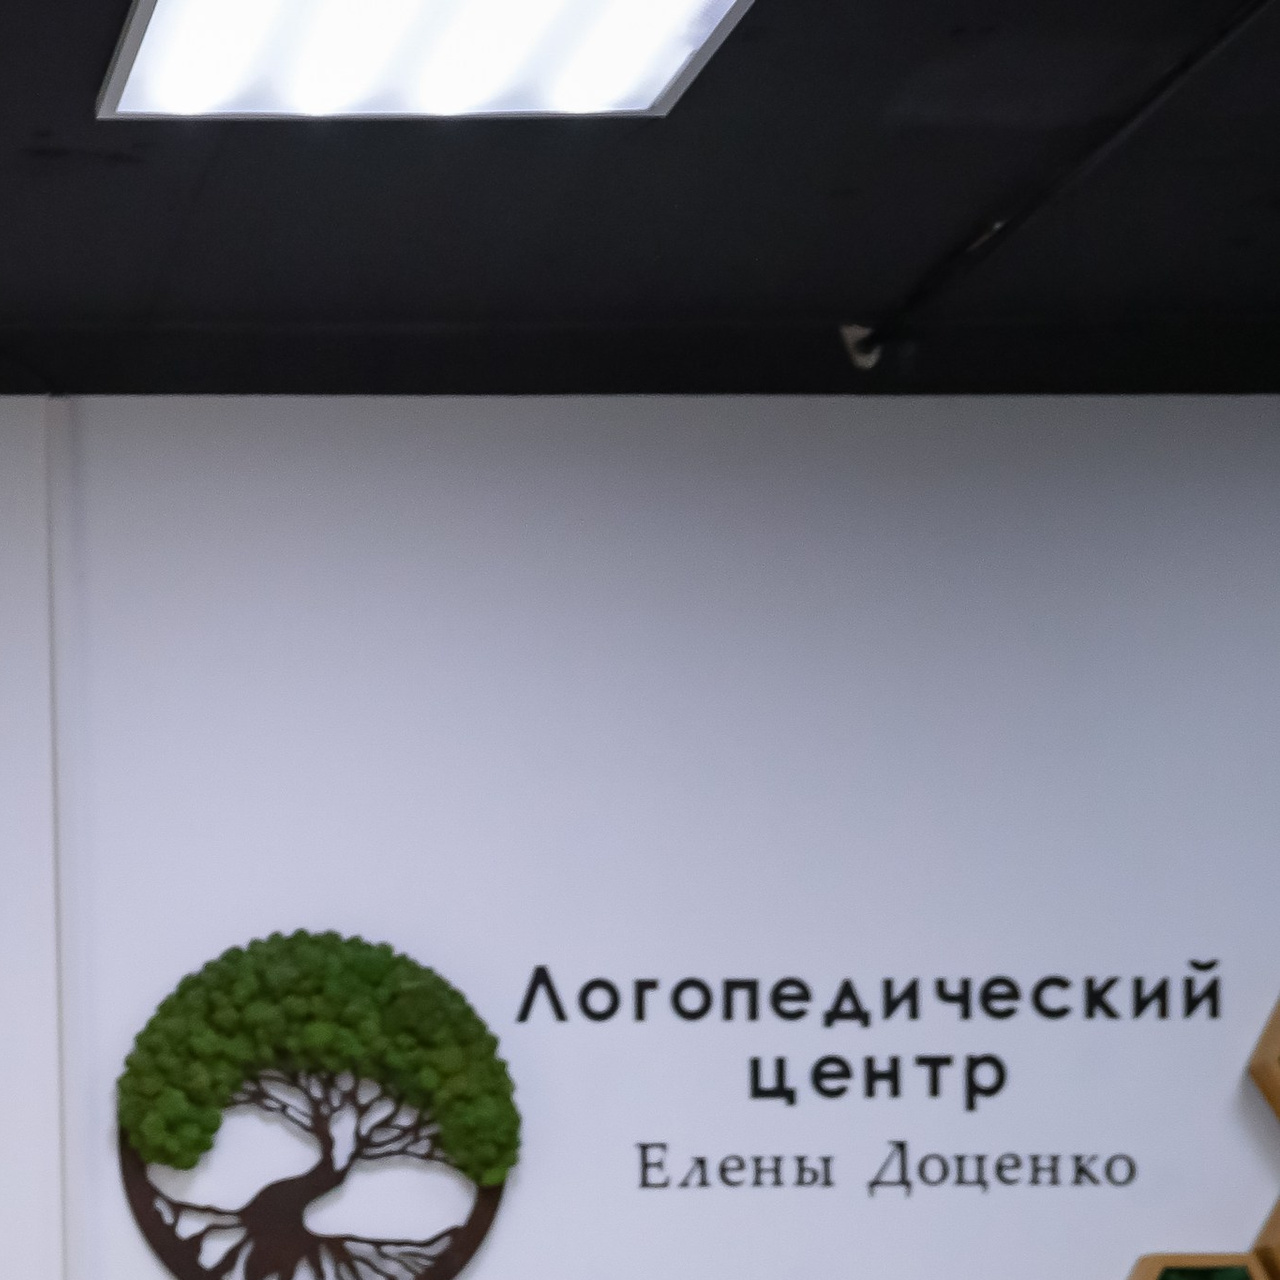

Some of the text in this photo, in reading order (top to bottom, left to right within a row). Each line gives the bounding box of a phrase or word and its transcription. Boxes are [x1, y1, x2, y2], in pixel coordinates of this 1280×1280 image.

[516, 960, 1222, 1028] Логопедический
[749, 1052, 1008, 1111] центр
[635, 1140, 1138, 1197] Елены Доценко
